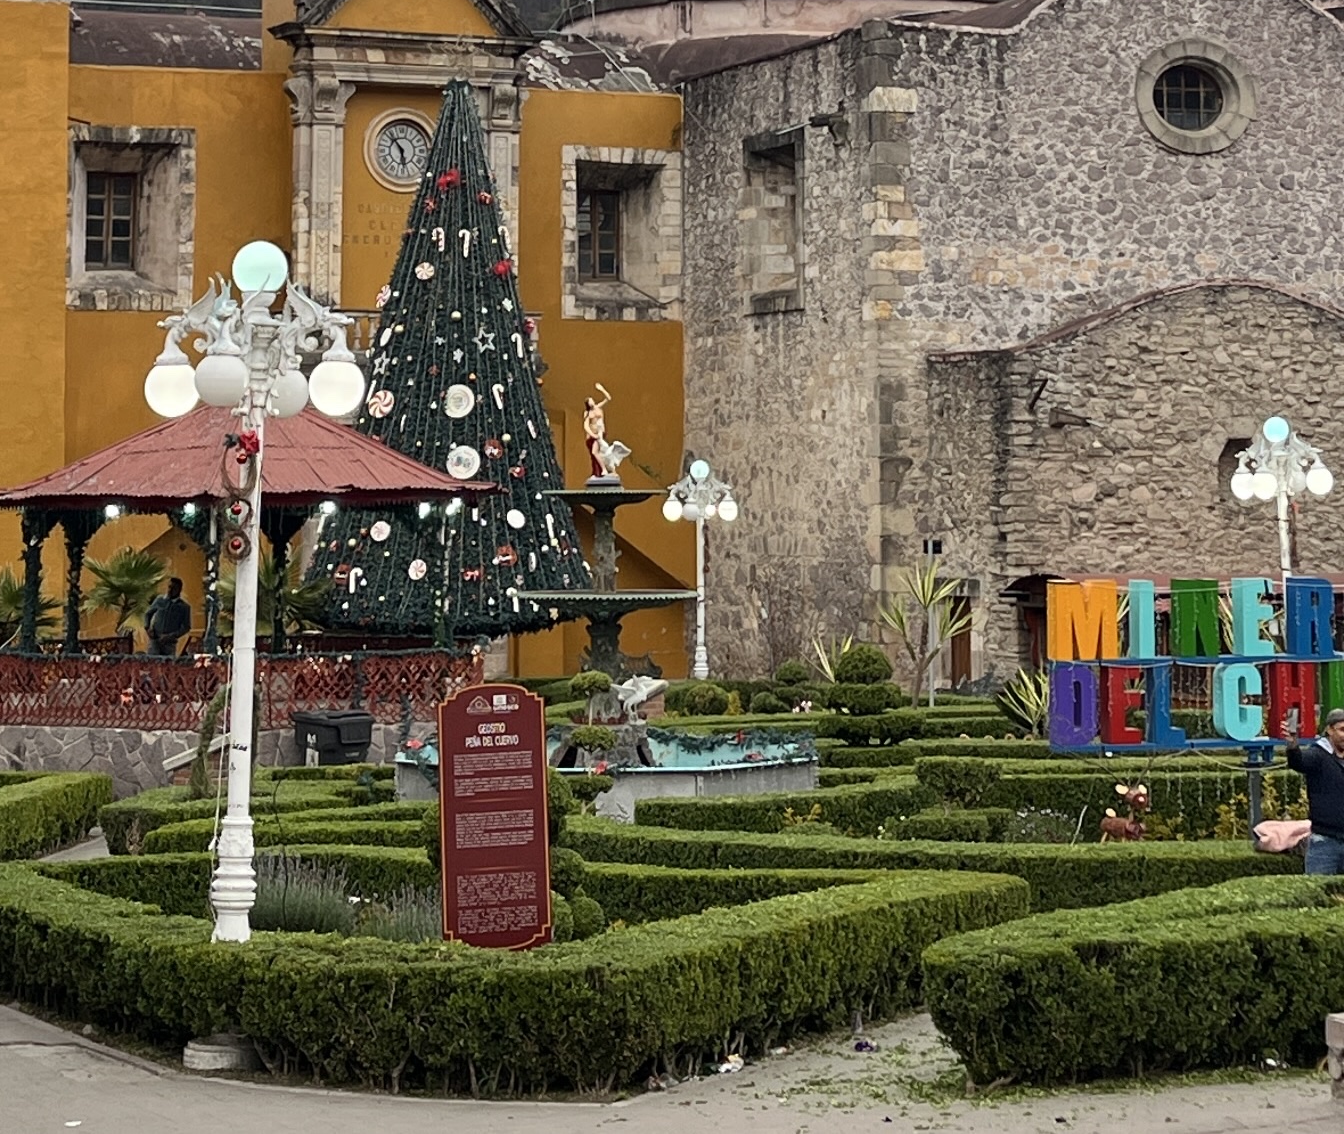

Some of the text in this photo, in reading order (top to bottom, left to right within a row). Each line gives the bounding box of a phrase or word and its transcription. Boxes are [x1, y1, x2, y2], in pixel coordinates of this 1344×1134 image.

[1049, 661, 1187, 748] DEL
[482, 735, 494, 747] DEL
[494, 734, 519, 746] CUERVO
